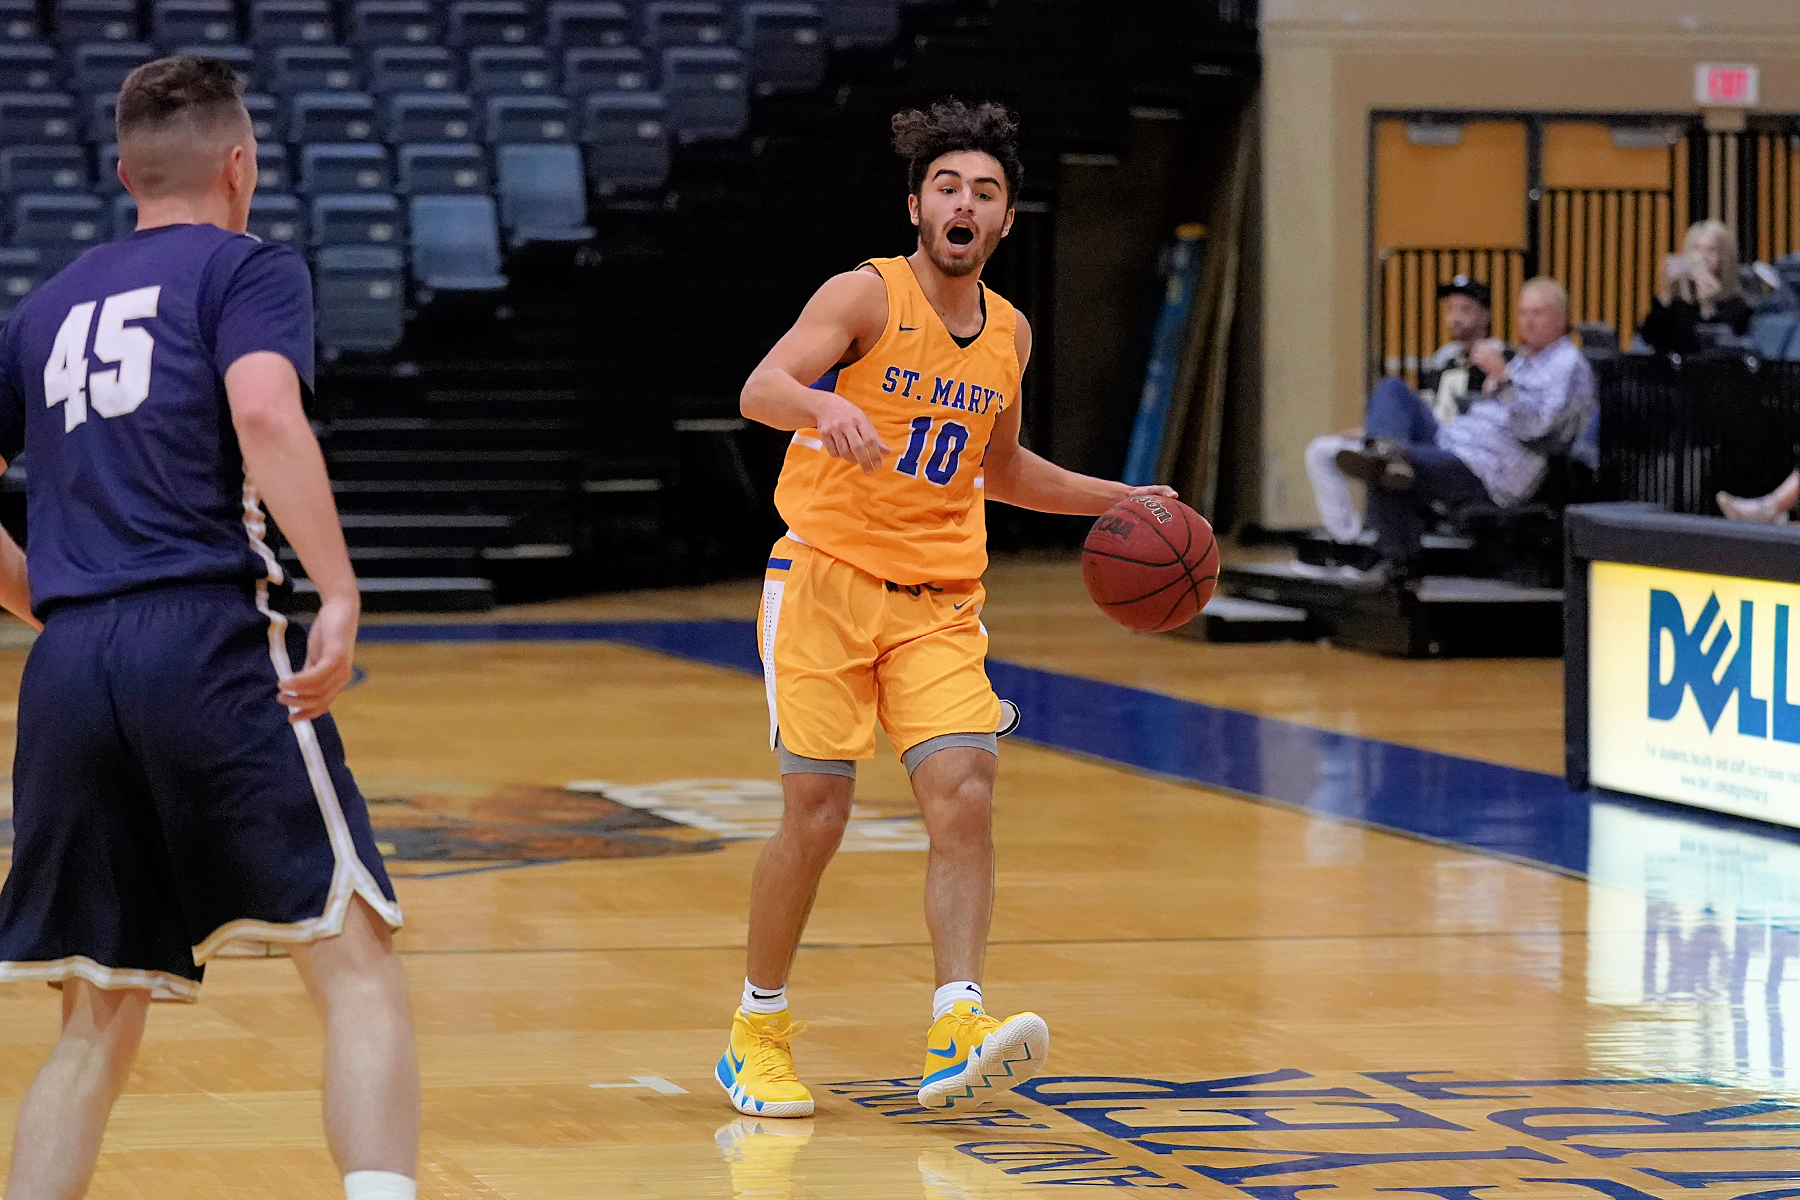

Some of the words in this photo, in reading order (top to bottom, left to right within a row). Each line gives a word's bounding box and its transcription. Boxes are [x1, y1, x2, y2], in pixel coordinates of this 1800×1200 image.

[44, 286, 161, 434] 45
[881, 365, 922, 401] ST.
[894, 415, 970, 488] 10
[1648, 588, 1800, 744] DELL
